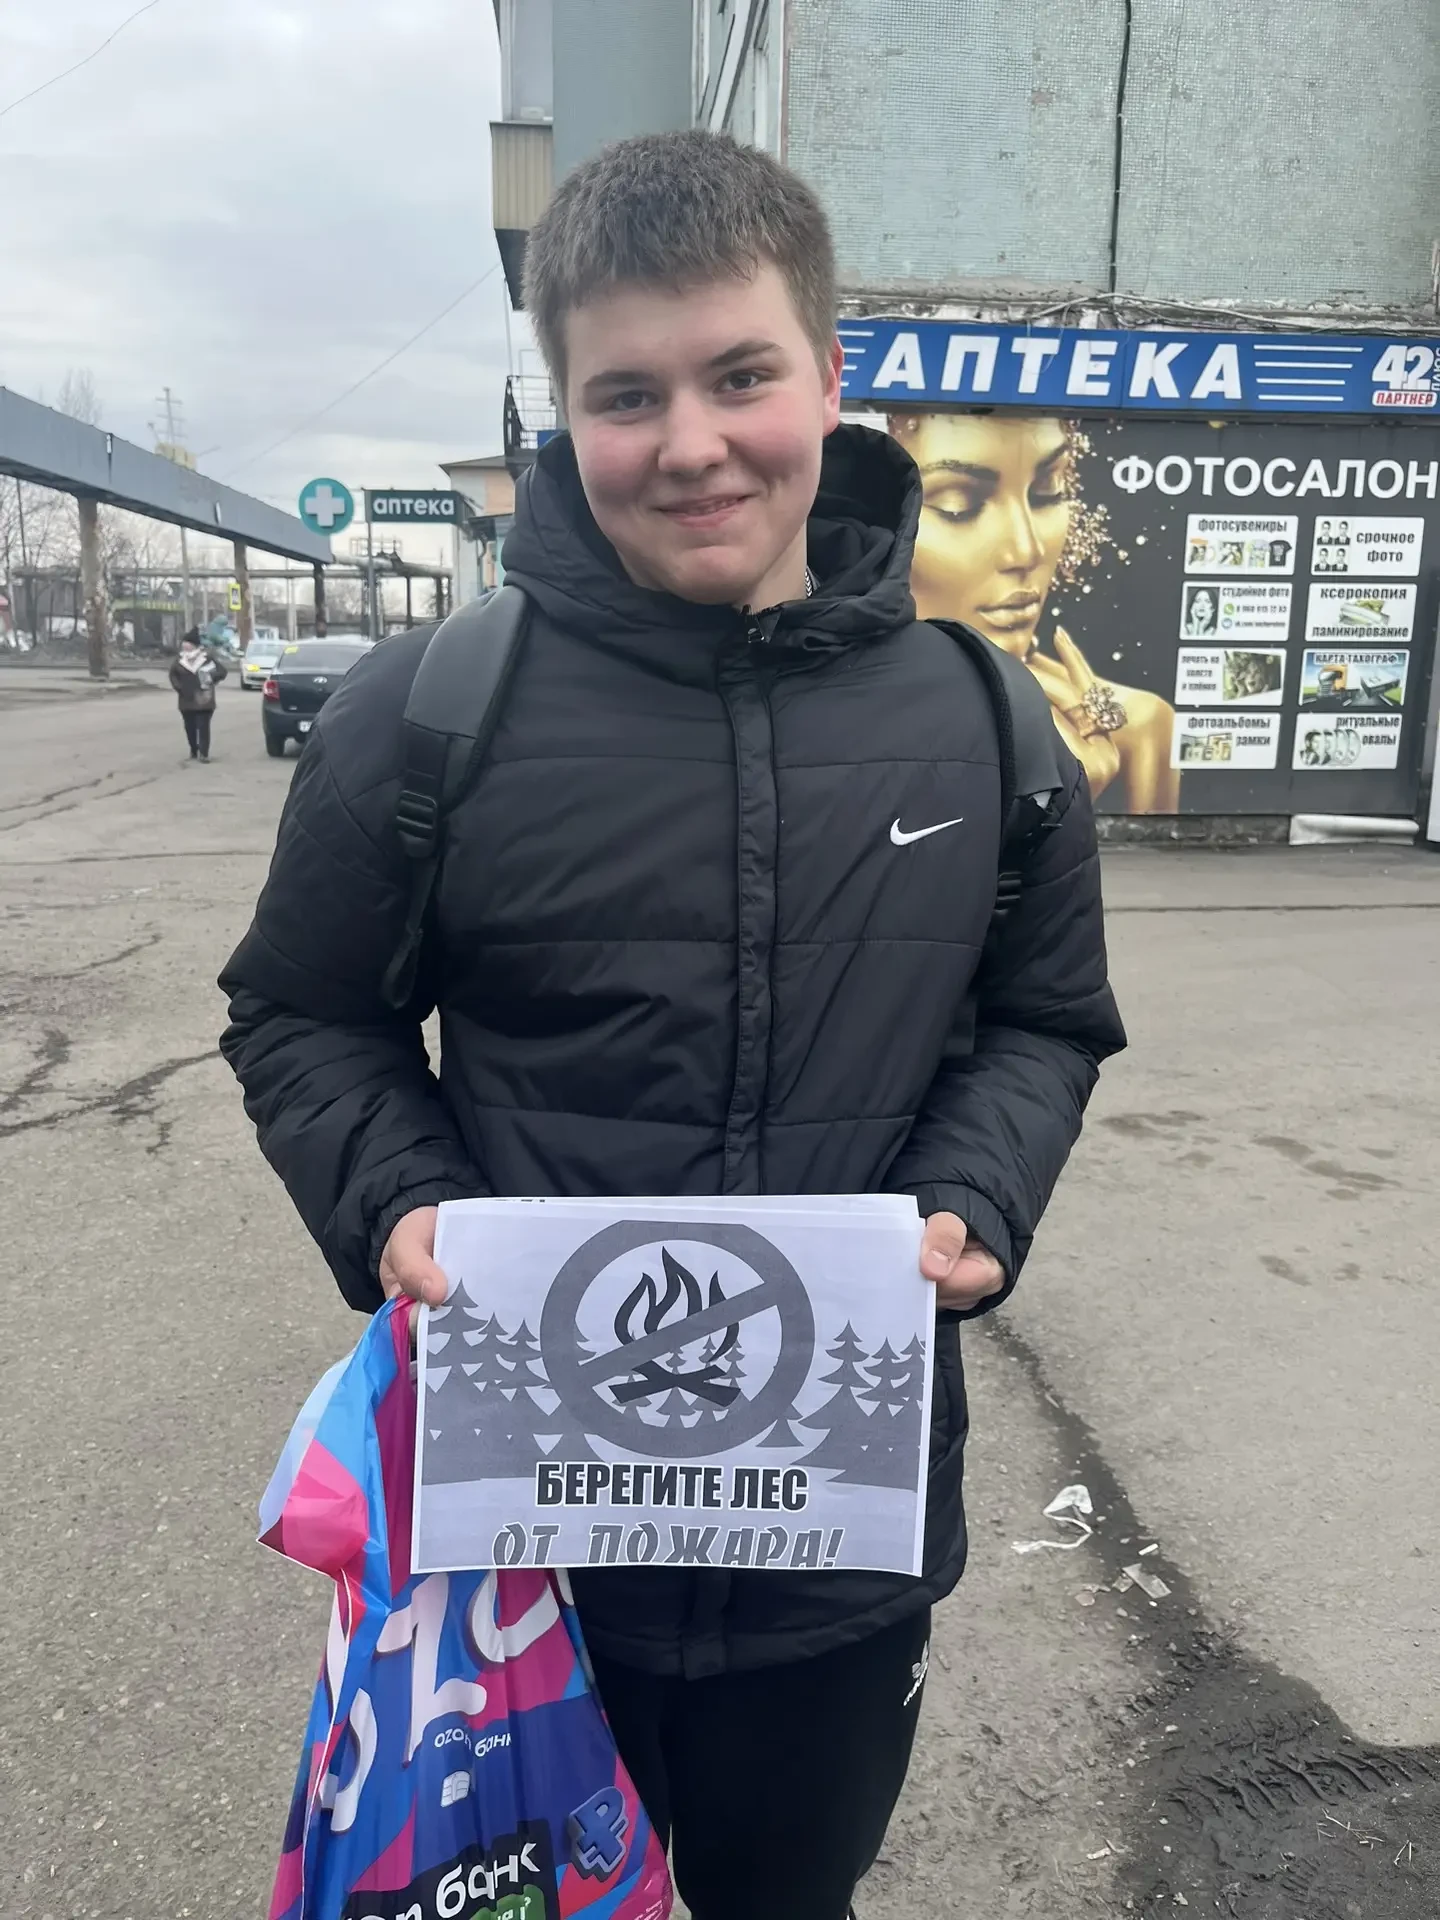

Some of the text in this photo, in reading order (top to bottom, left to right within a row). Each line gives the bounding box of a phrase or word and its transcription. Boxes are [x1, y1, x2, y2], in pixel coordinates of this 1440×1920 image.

[872, 332, 1242, 399] АПТЕКА
[1372, 345, 1434, 390] 42
[1376, 392, 1434, 405] ПАРТНЕР
[1112, 455, 1439, 499] ФОТОСАЛОН
[373, 498, 454, 515] аптека
[1198, 519, 1288, 533] фотосувениры
[1356, 532, 1415, 545] срочное
[1367, 549, 1403, 563] фото
[1320, 587, 1407, 600] ксерокопия
[1312, 627, 1409, 638] ламинирование
[1188, 717, 1271, 729] фотоальбомы
[1336, 717, 1400, 729] ритуальные
[1362, 735, 1396, 746] овалы
[536, 1462, 808, 1511] БЕРЕГИТЕ ЛЕС
[492, 1521, 845, 1568] ОТ ПОЖАРА!
